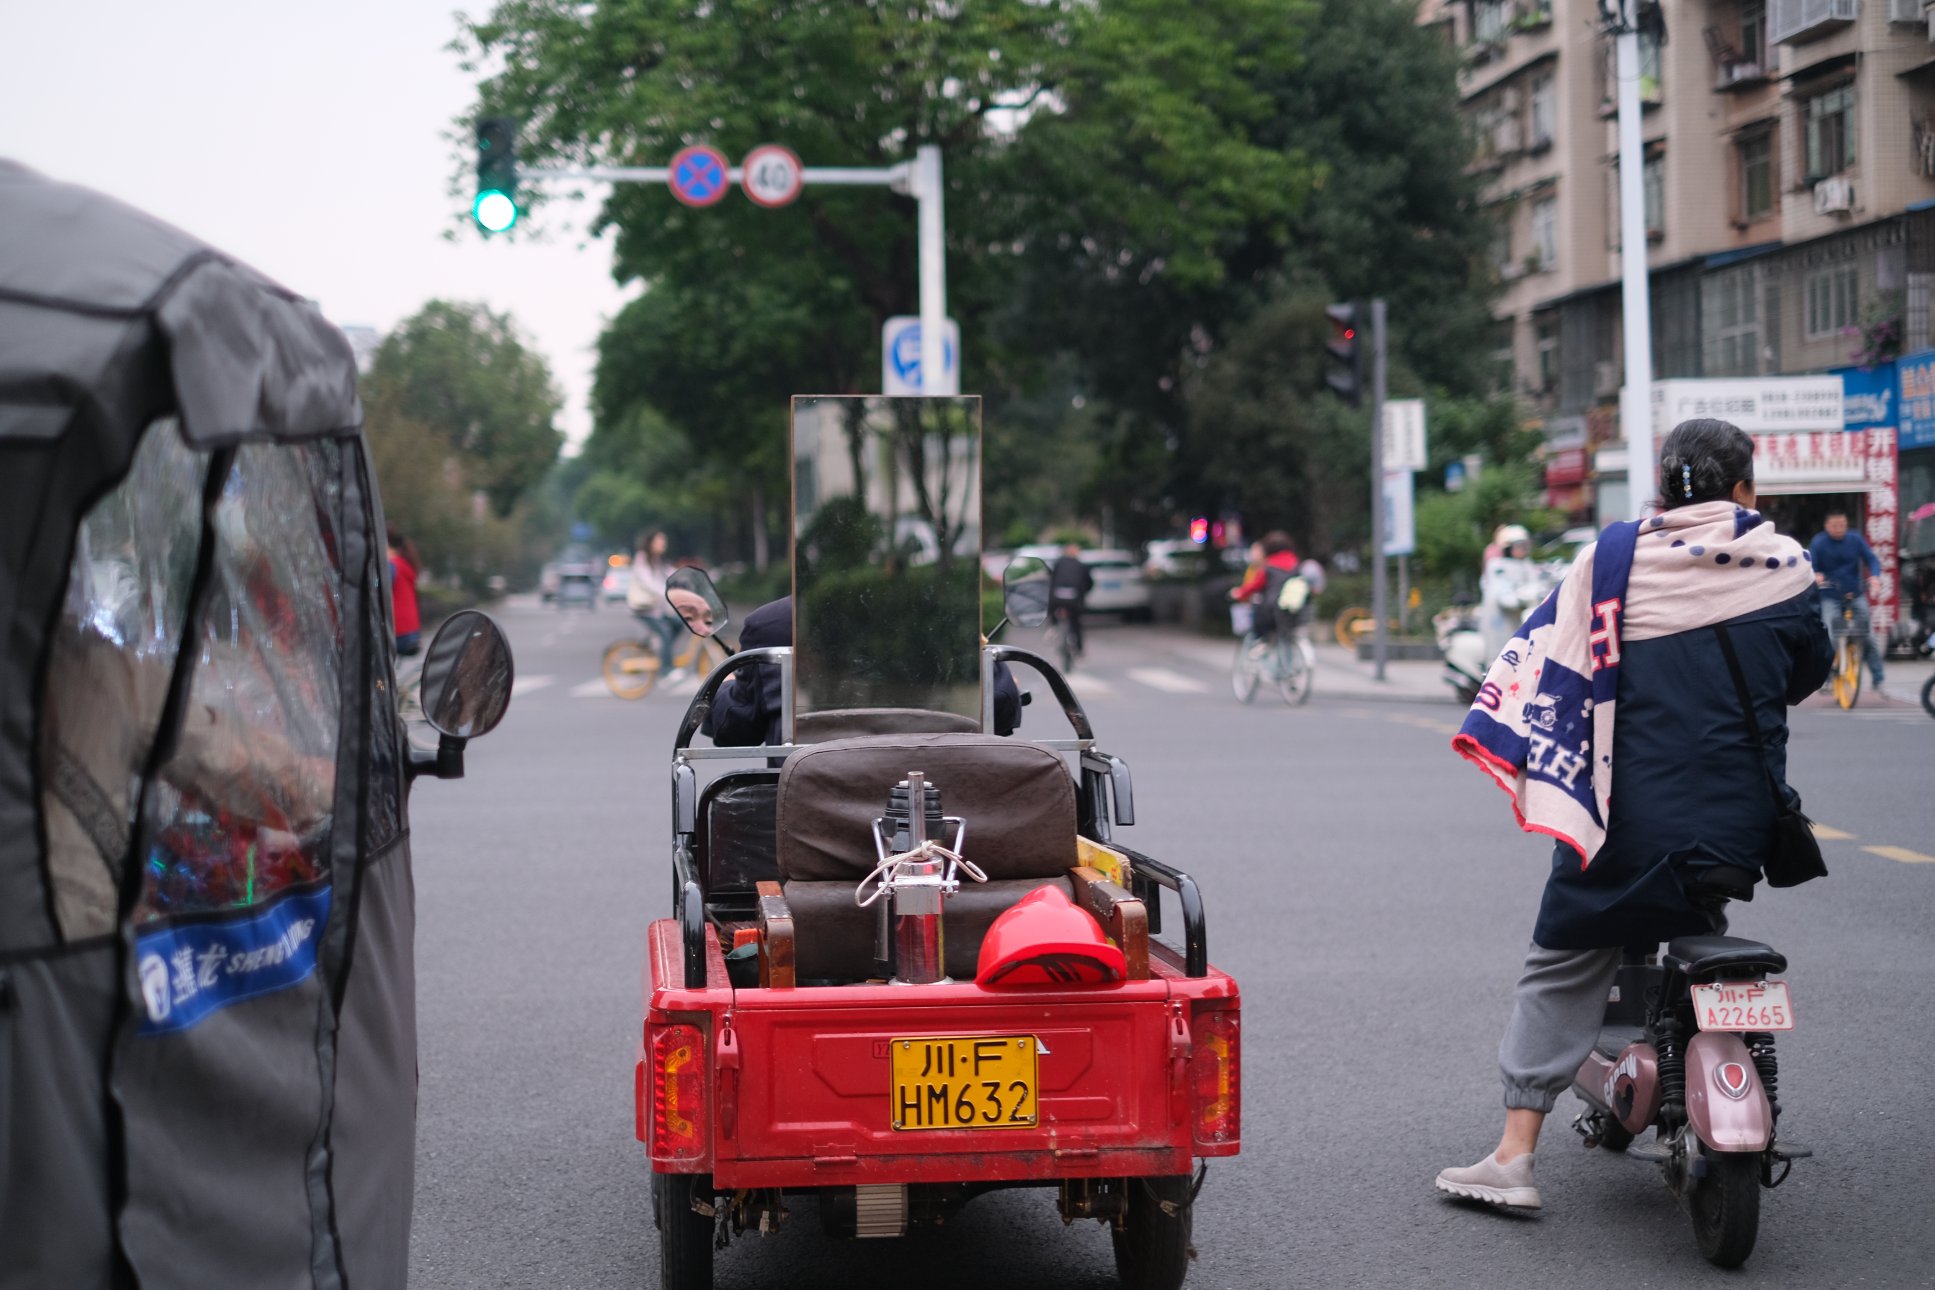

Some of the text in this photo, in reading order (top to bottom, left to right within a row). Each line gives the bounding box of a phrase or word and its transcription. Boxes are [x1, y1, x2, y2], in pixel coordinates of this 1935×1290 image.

[756, 163, 788, 191] 40
[1707, 1005, 1785, 1026] A22665
[900, 1081, 1031, 1126] HM632
